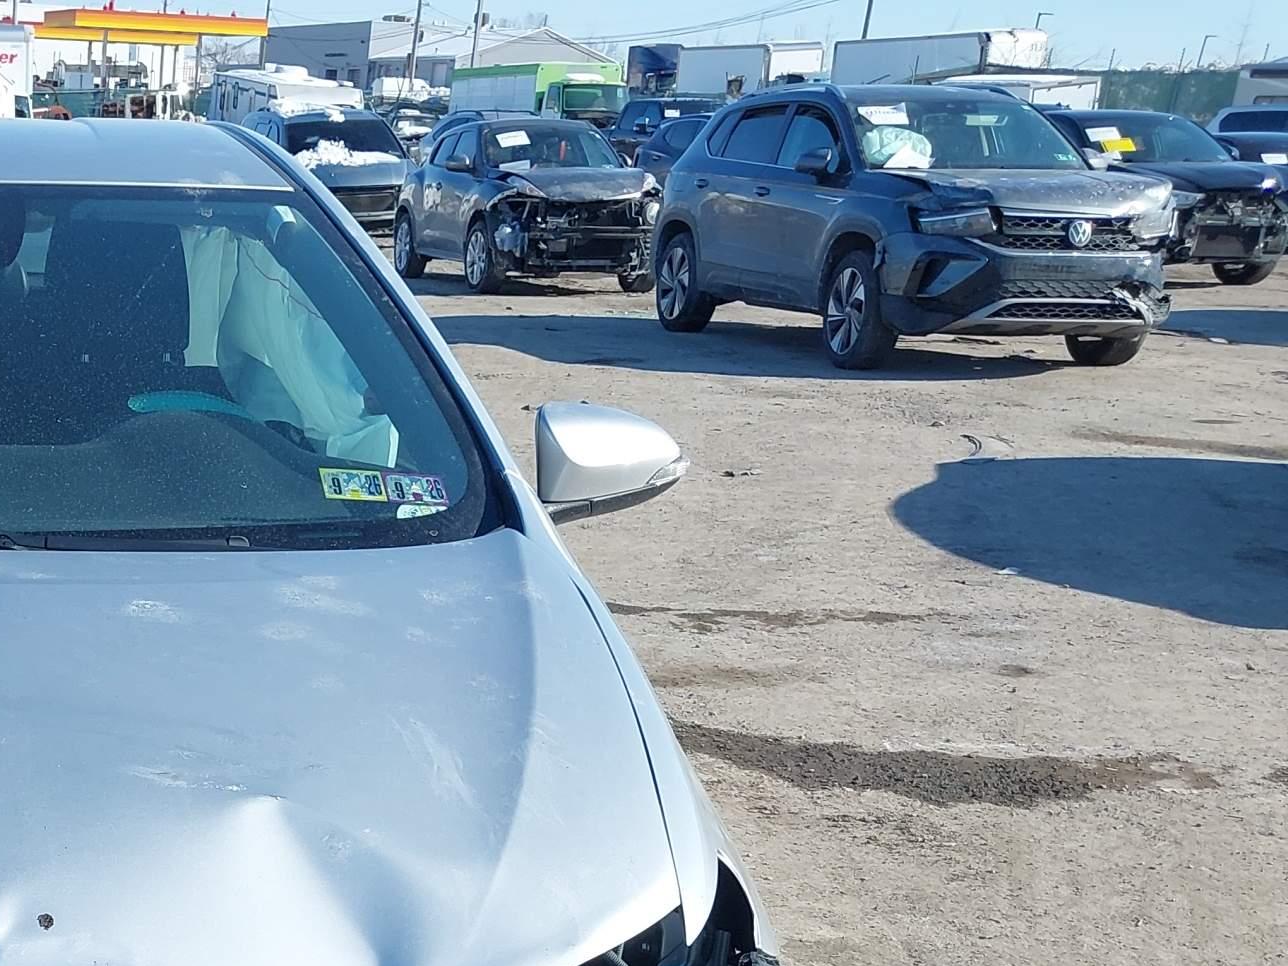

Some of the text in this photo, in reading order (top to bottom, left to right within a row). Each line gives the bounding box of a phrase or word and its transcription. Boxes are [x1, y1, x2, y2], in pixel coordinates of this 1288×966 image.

[331, 474, 383, 496] 9 26
[394, 478, 445, 499] 9 26
